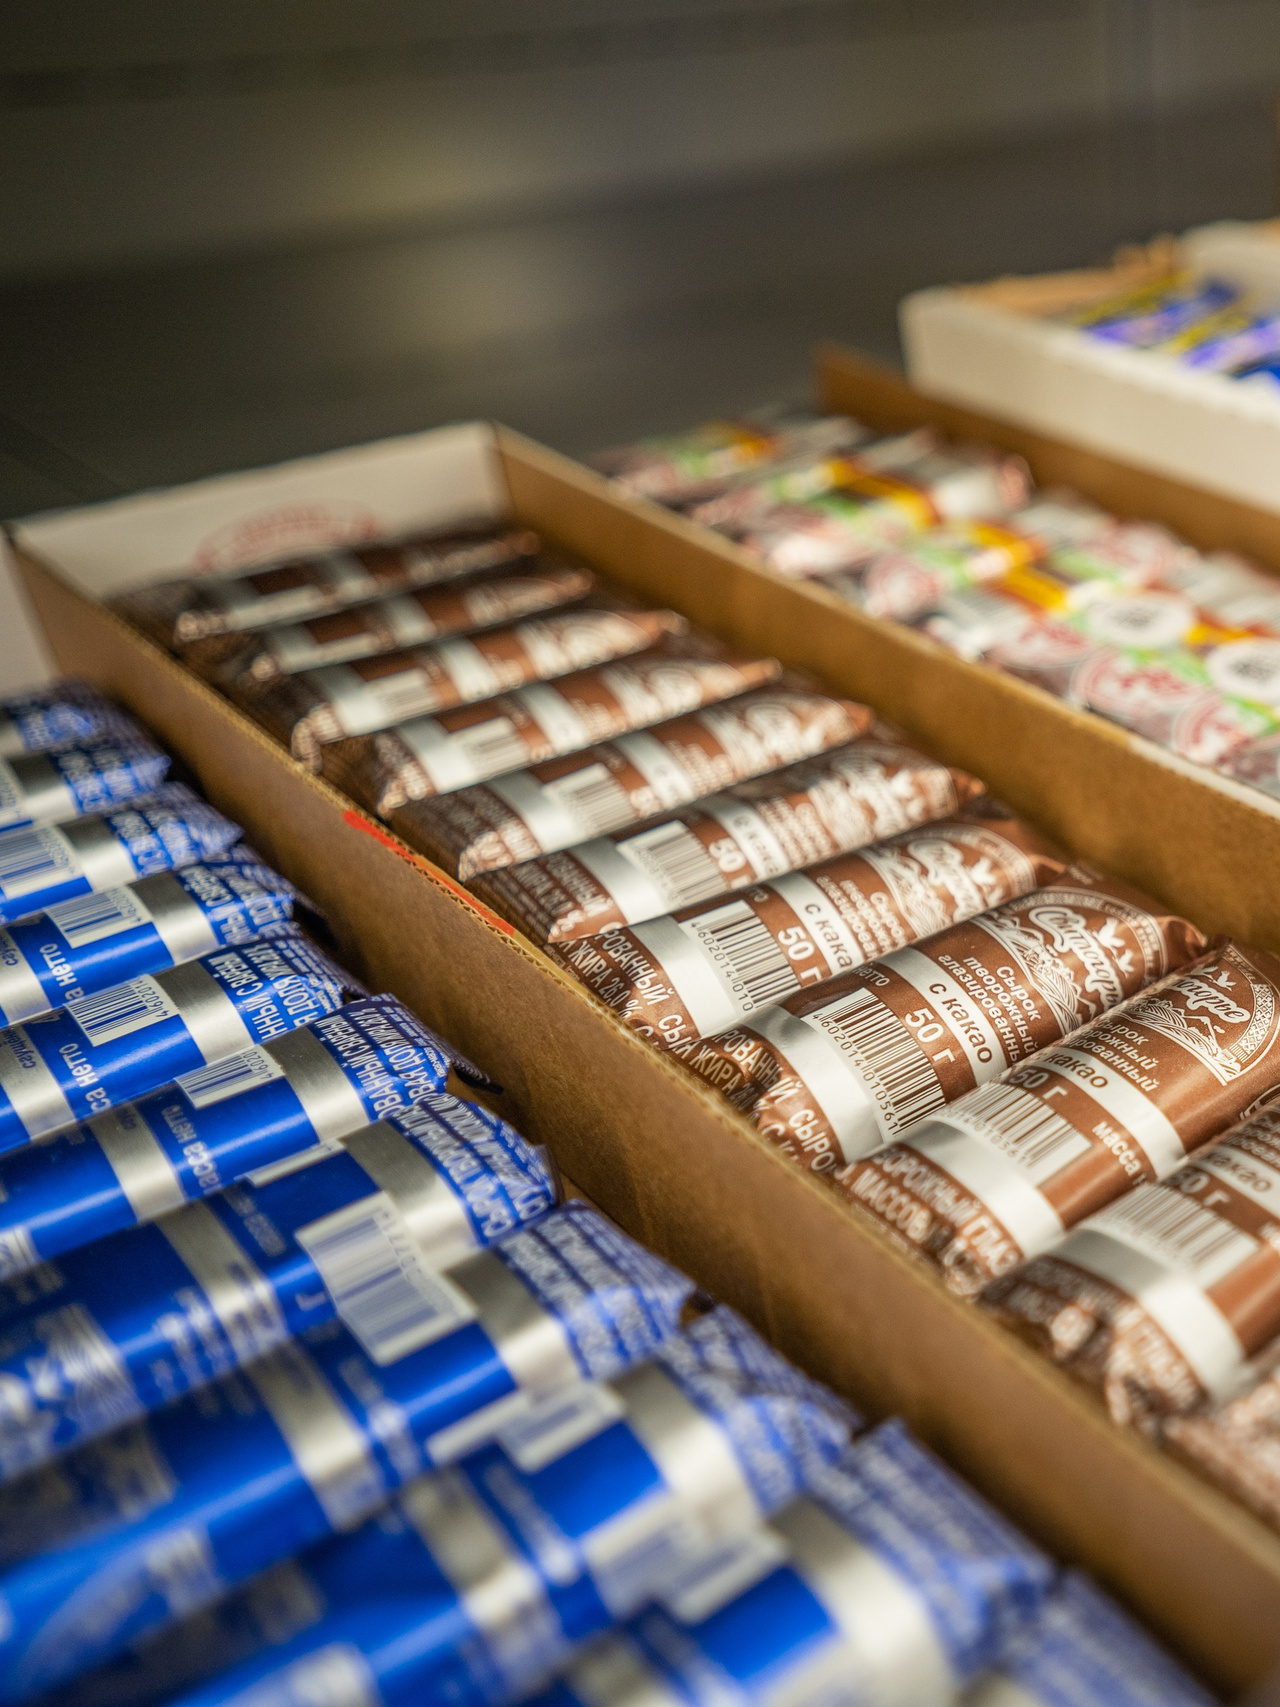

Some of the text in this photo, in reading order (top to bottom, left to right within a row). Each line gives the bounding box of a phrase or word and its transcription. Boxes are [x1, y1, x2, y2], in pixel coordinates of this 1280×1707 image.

[777, 925, 815, 961] 50
[815, 919, 853, 970] кака
[869, 891, 907, 946] Сыро
[40, 943, 78, 987] нетто
[236, 978, 264, 999] С
[571, 940, 608, 993] ЖИРА
[594, 929, 670, 1007] РОВАННЫЙ
[235, 990, 287, 1039] ННЫЙ
[271, 973, 317, 1016] ДОЛЯ
[937, 953, 1022, 1063] глазированн
[962, 956, 1040, 1055] творожный
[995, 964, 1043, 1023] Сырок
[904, 1007, 956, 1066] 50 г
[928, 981, 993, 1065] с какао
[1082, 1029, 1160, 1071] орожный
[58, 1042, 100, 1088] нетто
[340, 1048, 404, 1120] ОВАННЫЙ
[379, 1043, 426, 1072] ДОЛЯ
[398, 1065, 435, 1103] ОВАЯ
[688, 1043, 745, 1098] ЖИРА
[1008, 1069, 1068, 1100] 50 г
[1069, 1038, 1161, 1093] рованный
[713, 1028, 842, 1176] РОВАННЫЙ СЫРО
[1091, 1120, 1142, 1176] масса
